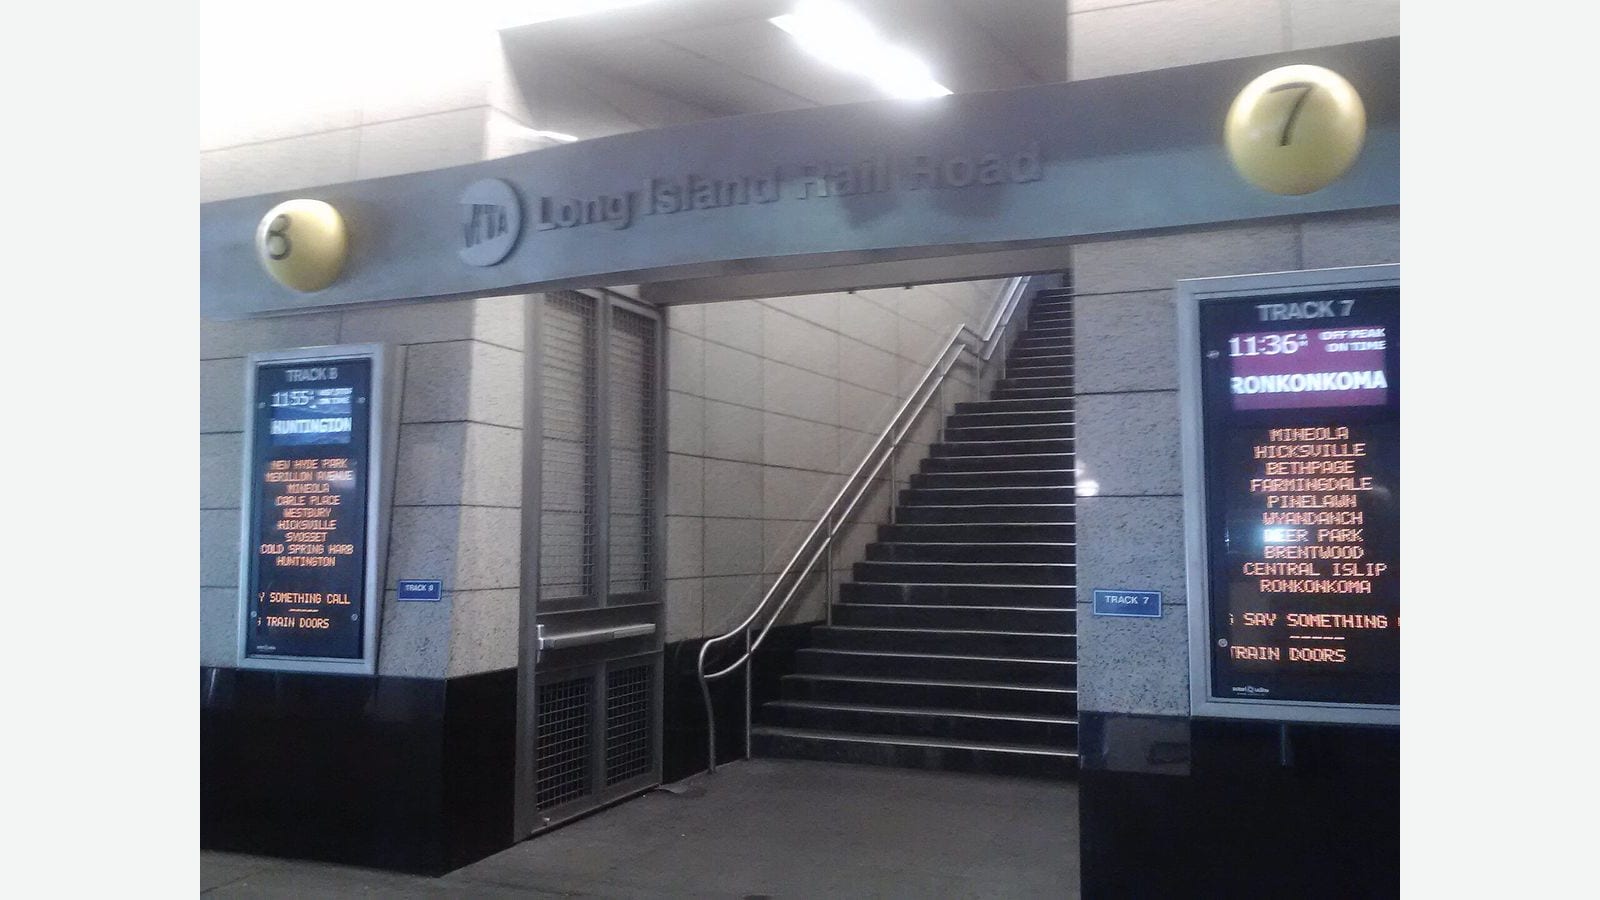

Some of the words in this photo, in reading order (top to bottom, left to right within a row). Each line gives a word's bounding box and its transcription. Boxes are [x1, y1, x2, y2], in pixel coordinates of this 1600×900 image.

[1266, 81, 1319, 147] 7
[535, 190, 638, 232] Long
[643, 164, 780, 217] Island
[796, 158, 893, 201] Rail
[903, 142, 1046, 193] Road
[460, 202, 509, 248] MTA
[1256, 300, 1335, 321] TRACK
[1339, 299, 1355, 317] 7
[1228, 333, 1299, 357] 11:36
[1325, 343, 1348, 352] ON
[1349, 340, 1387, 351] TIME
[285, 367, 328, 382] TRACK
[1230, 370, 1388, 394] RONKONKOMA
[270, 417, 352, 435] HUNTINGTON
[1268, 426, 1349, 441] MINEOLA
[1253, 443, 1366, 459] HICKSVILLE
[270, 459, 290, 470] NEW
[294, 458, 318, 470] HYDE
[322, 458, 348, 469] PARK
[1265, 460, 1356, 475] BETHPAGE
[265, 472, 313, 482] MERILLON
[317, 470, 354, 481] AVENUE
[287, 483, 330, 494] MINEOLA
[1250, 477, 1373, 492] FARMINGDALE
[275, 496, 306, 506] CARLE
[310, 495, 341, 506] PLACE
[1266, 494, 1357, 509] PINELAWN
[283, 508, 332, 518] WESTBURY
[1262, 511, 1363, 525] WYANDANCH
[276, 519, 337, 530] HICKSVILLE
[285, 531, 328, 542] SYOSSET
[1317, 528, 1364, 542] PARK
[260, 544, 284, 555] COLD
[288, 544, 324, 555] SPRING
[328, 543, 354, 555] HARB
[1263, 545, 1365, 560] BRENTWOOD
[276, 556, 336, 567] HUNTINGTON
[1243, 562, 1320, 576] CENTRAL
[1332, 562, 1388, 577] ISLIP
[405, 584, 427, 592] TRACK
[1260, 579, 1371, 594] RONKONKOMA
[269, 592, 322, 604] SOMETHING
[326, 593, 351, 605] CALL
[1104, 595, 1138, 604] TRACK
[1142, 596, 1150, 604] 7
[266, 616, 295, 627] TRAIN
[299, 617, 330, 629] DOORS
[1243, 612, 1277, 626] SAY
[1287, 613, 1388, 629] SOMETHING
[1230, 645, 1280, 661] TRAIN
[1289, 647, 1346, 663] DOORS
